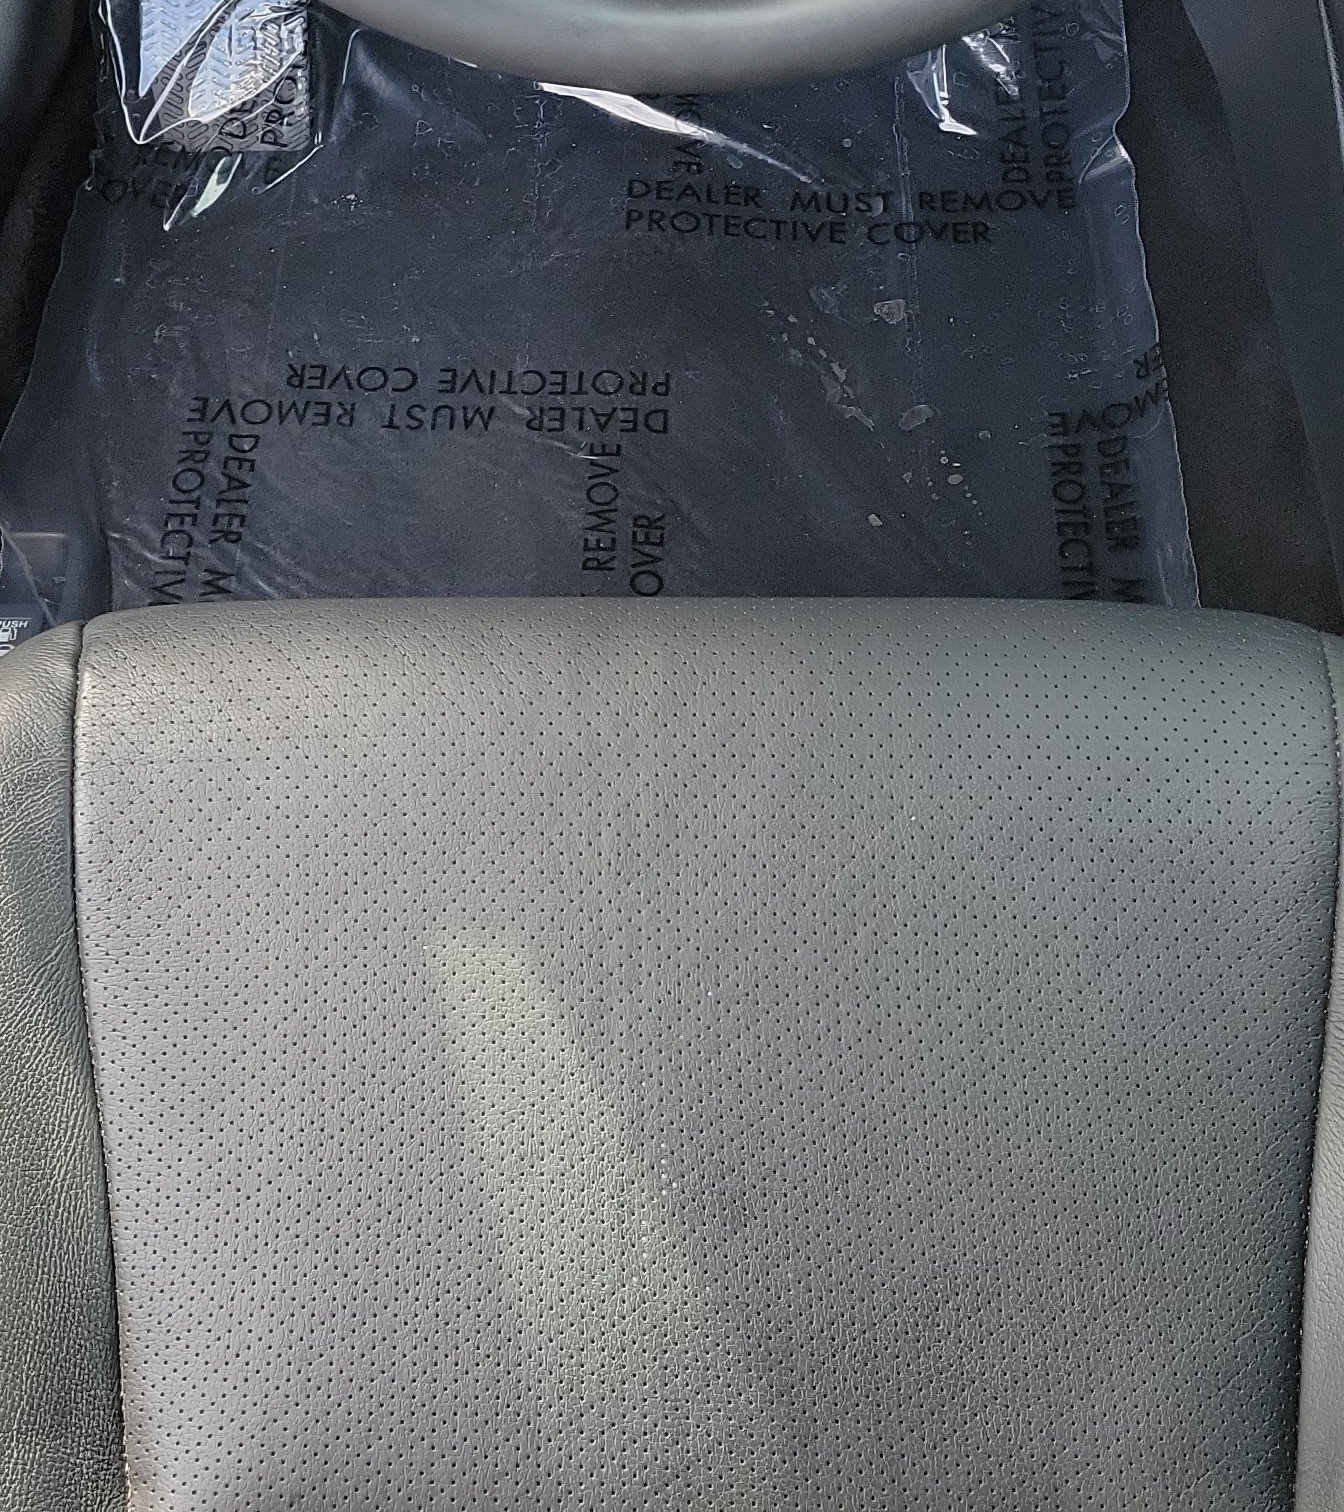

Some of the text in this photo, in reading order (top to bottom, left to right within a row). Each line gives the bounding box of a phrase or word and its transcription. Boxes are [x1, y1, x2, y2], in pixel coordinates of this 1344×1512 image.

[624, 209, 993, 246] PROTECTIVE COVER
[625, 178, 1077, 215] DEALER MUST REMOVE
[186, 395, 670, 435] DEALER MUST REMOVE
[285, 362, 672, 397] PROTECTIVE COVER
[148, 429, 213, 607] PROTECTIV
[207, 432, 260, 547] DEALER
[580, 441, 622, 573] REMOVE
[1096, 435, 1142, 552] DEALER
[630, 511, 668, 598] OVER
